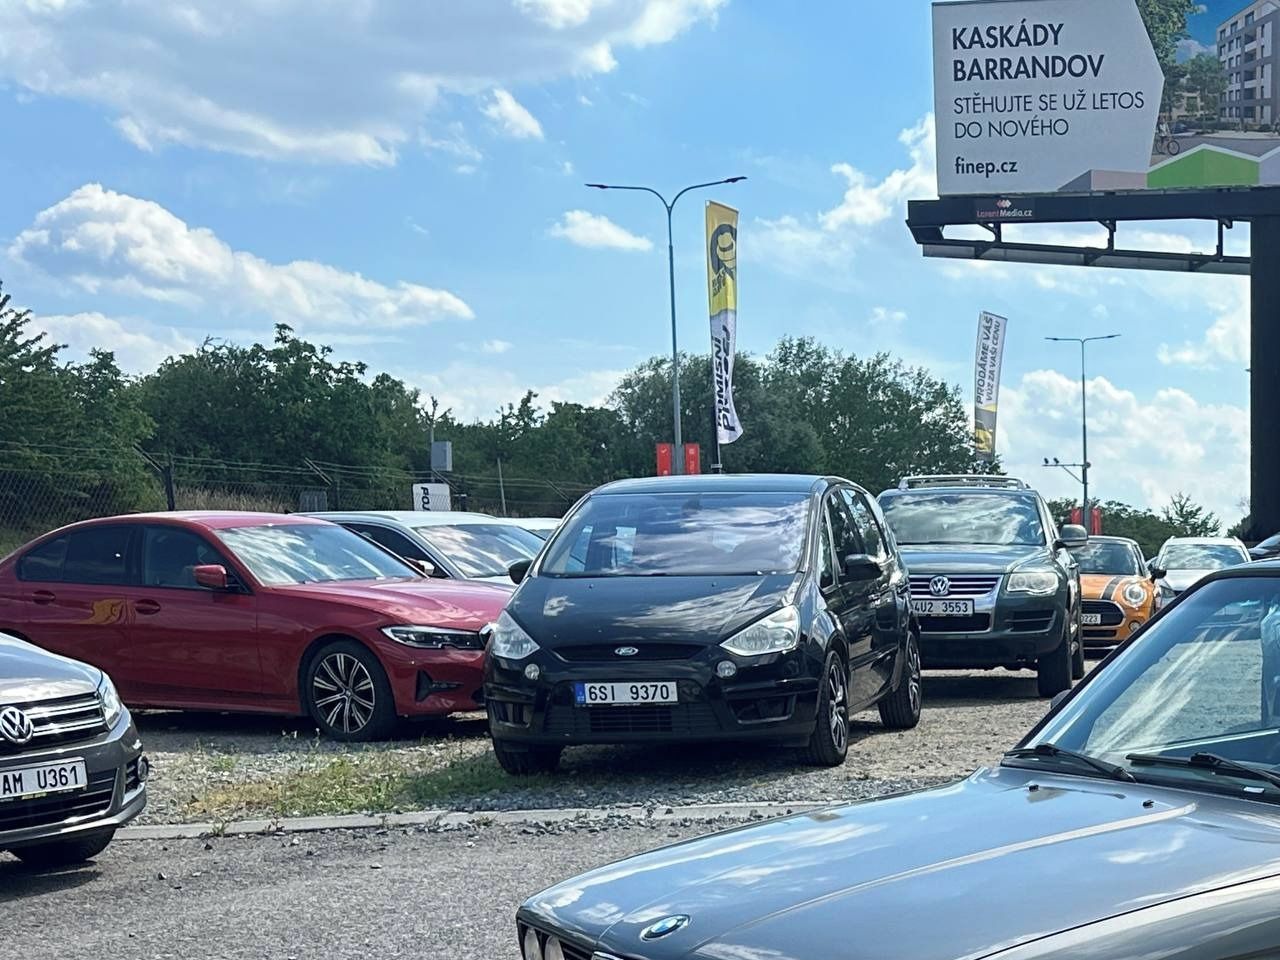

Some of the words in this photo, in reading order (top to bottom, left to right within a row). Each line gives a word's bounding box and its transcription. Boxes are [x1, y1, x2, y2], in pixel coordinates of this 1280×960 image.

[952, 18, 1064, 50] KASKÁDY
[953, 54, 1105, 82] BARRANDOV
[953, 92, 1033, 115] STĚHUJTE
[1038, 94, 1057, 112] SE
[1063, 88, 1087, 111] UŽ
[1092, 91, 1145, 110] LETOS
[954, 121, 983, 139] DO
[988, 115, 1069, 138] NOVÉHO
[954, 156, 1018, 178] finep.cz
[977, 343, 989, 404] PRODÁME
[983, 315, 993, 340] VÁŠ
[988, 370, 996, 383] ZA
[992, 320, 1001, 346] CENU
[914, 602, 933, 613] 4U2
[942, 602, 968, 613] 3553
[630, 684, 669, 700] 9370
[36, 765, 78, 789] U361
